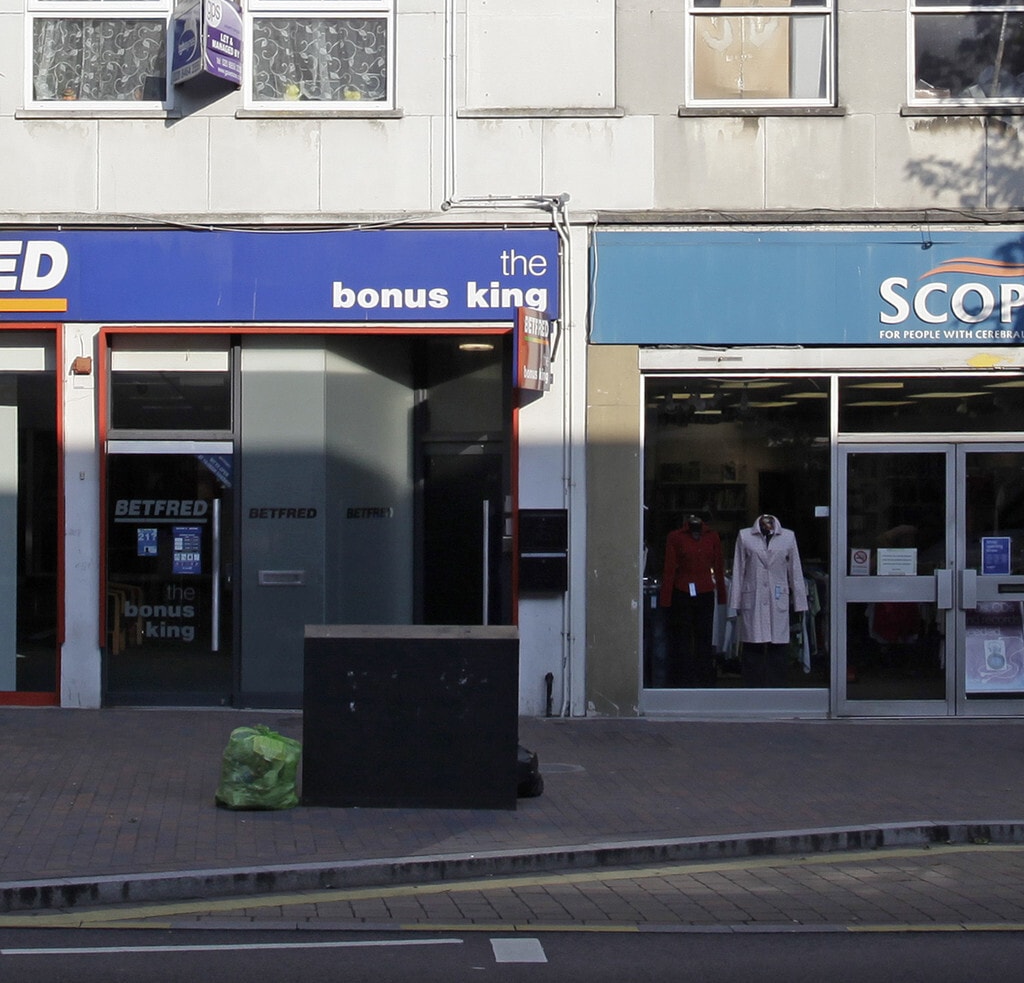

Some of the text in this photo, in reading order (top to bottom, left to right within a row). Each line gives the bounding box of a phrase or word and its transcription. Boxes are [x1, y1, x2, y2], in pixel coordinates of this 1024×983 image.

[500, 248, 548, 275] the
[332, 281, 548, 312] bonus king
[524, 316, 549, 338] BETFRED
[879, 330, 900, 339] FOR
[903, 330, 940, 339] PEOPLE
[943, 330, 973, 339] WITH
[115, 499, 209, 516] BETFRED
[248, 507, 317, 519] BETFRED
[346, 506, 395, 519] BETFRED
[166, 583, 196, 601] the
[124, 600, 195, 617] bonus
[146, 621, 195, 643] king
